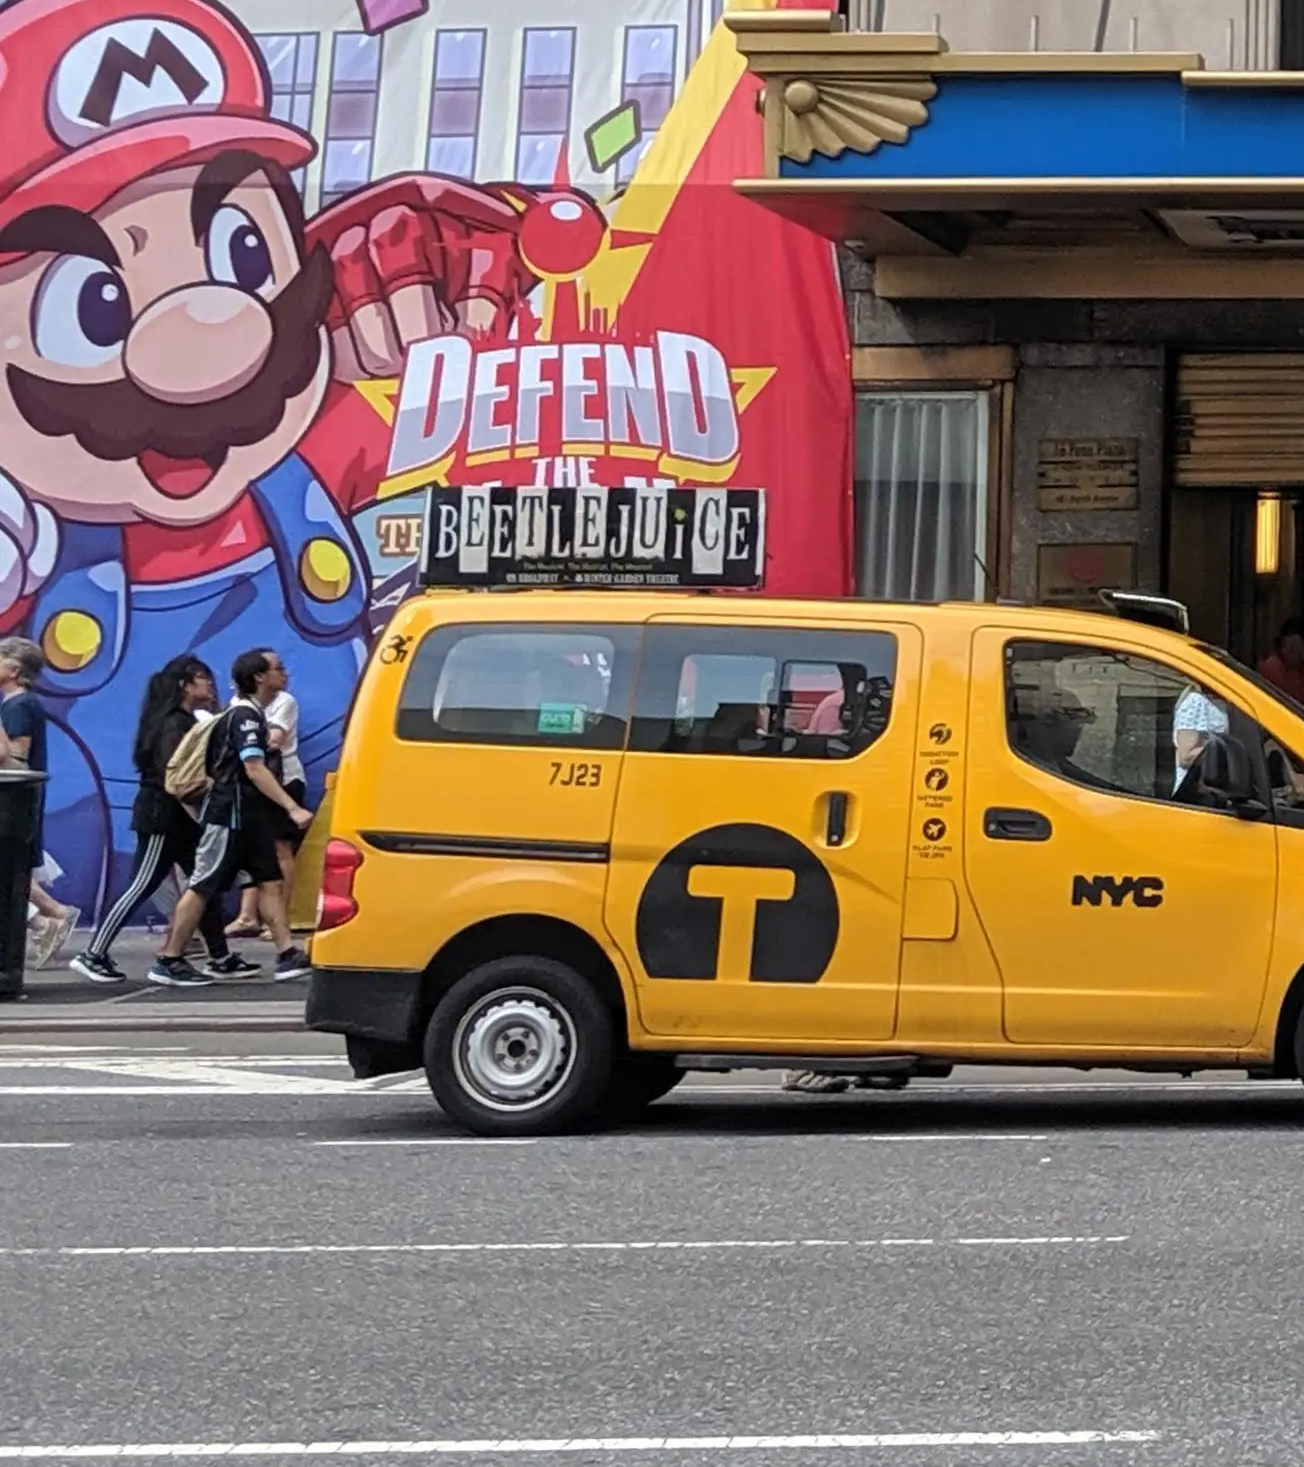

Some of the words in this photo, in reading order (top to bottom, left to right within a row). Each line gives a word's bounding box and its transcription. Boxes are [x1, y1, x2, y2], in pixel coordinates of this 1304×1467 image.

[78, 26, 210, 128] M
[385, 329, 740, 478] DEFEND
[532, 456, 598, 487] THE
[548, 761, 603, 787] 7J23
[686, 864, 797, 981] T
[1071, 874, 1165, 908] NYC
